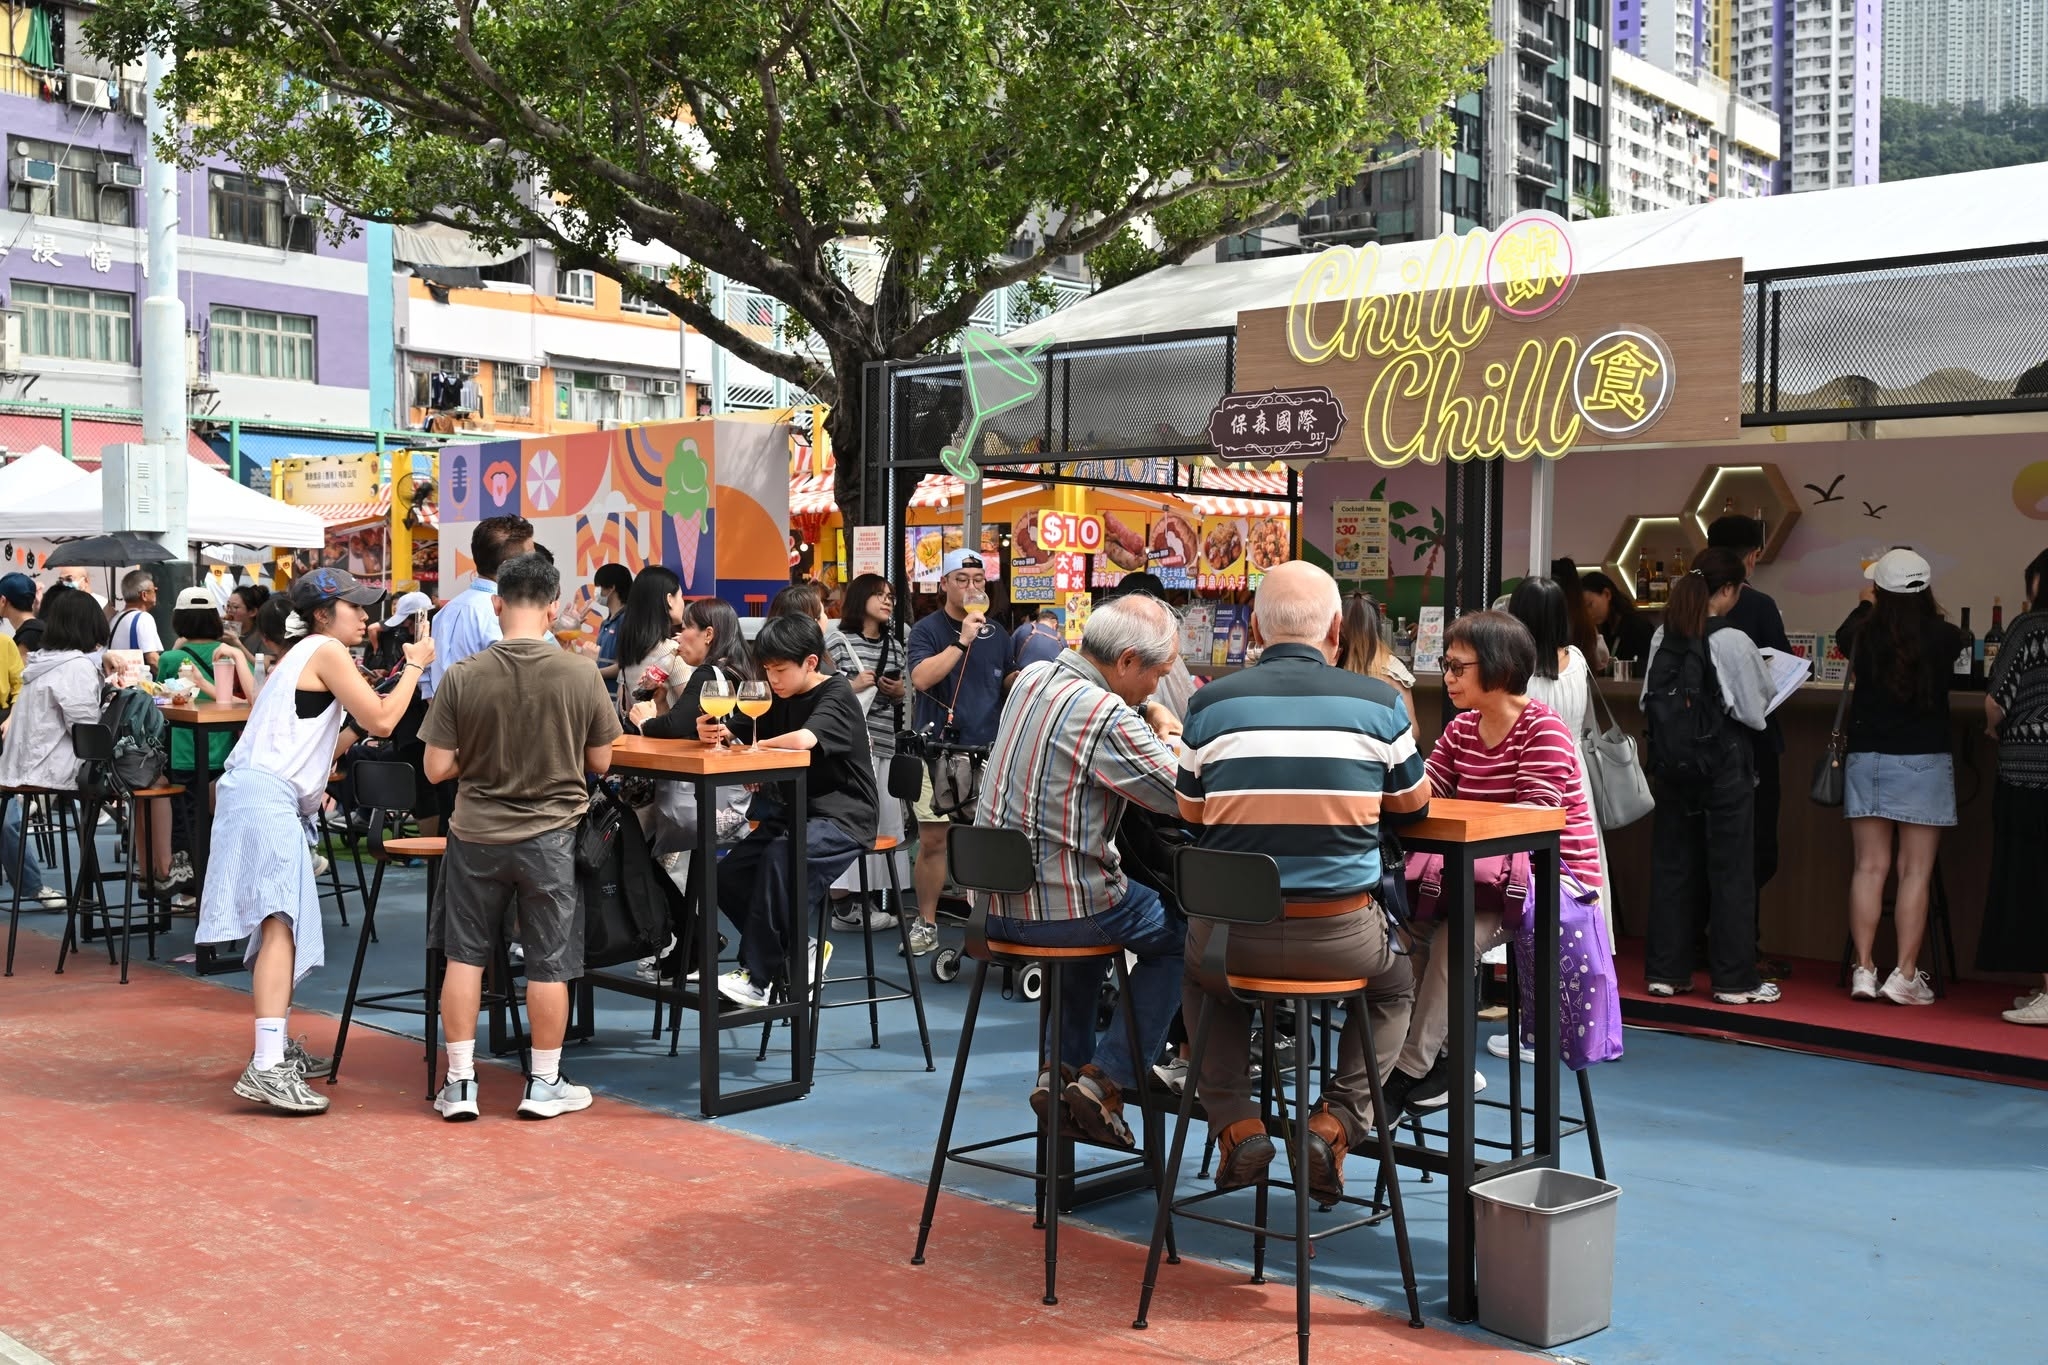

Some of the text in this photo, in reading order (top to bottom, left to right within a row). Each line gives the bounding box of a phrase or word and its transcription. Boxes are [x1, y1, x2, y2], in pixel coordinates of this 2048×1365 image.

[1496, 226, 1566, 307] 飲
[1288, 230, 1491, 363] Chill
[1584, 340, 1659, 420] 食
[1364, 336, 1581, 466] Chill
[1230, 408, 1318, 435] 保森國際
[1310, 432, 1325, 440] D17
[1042, 514, 1101, 547] $10
[1336, 525, 1357, 536] $30
[1197, 575, 1246, 590] 章魚小丸子
